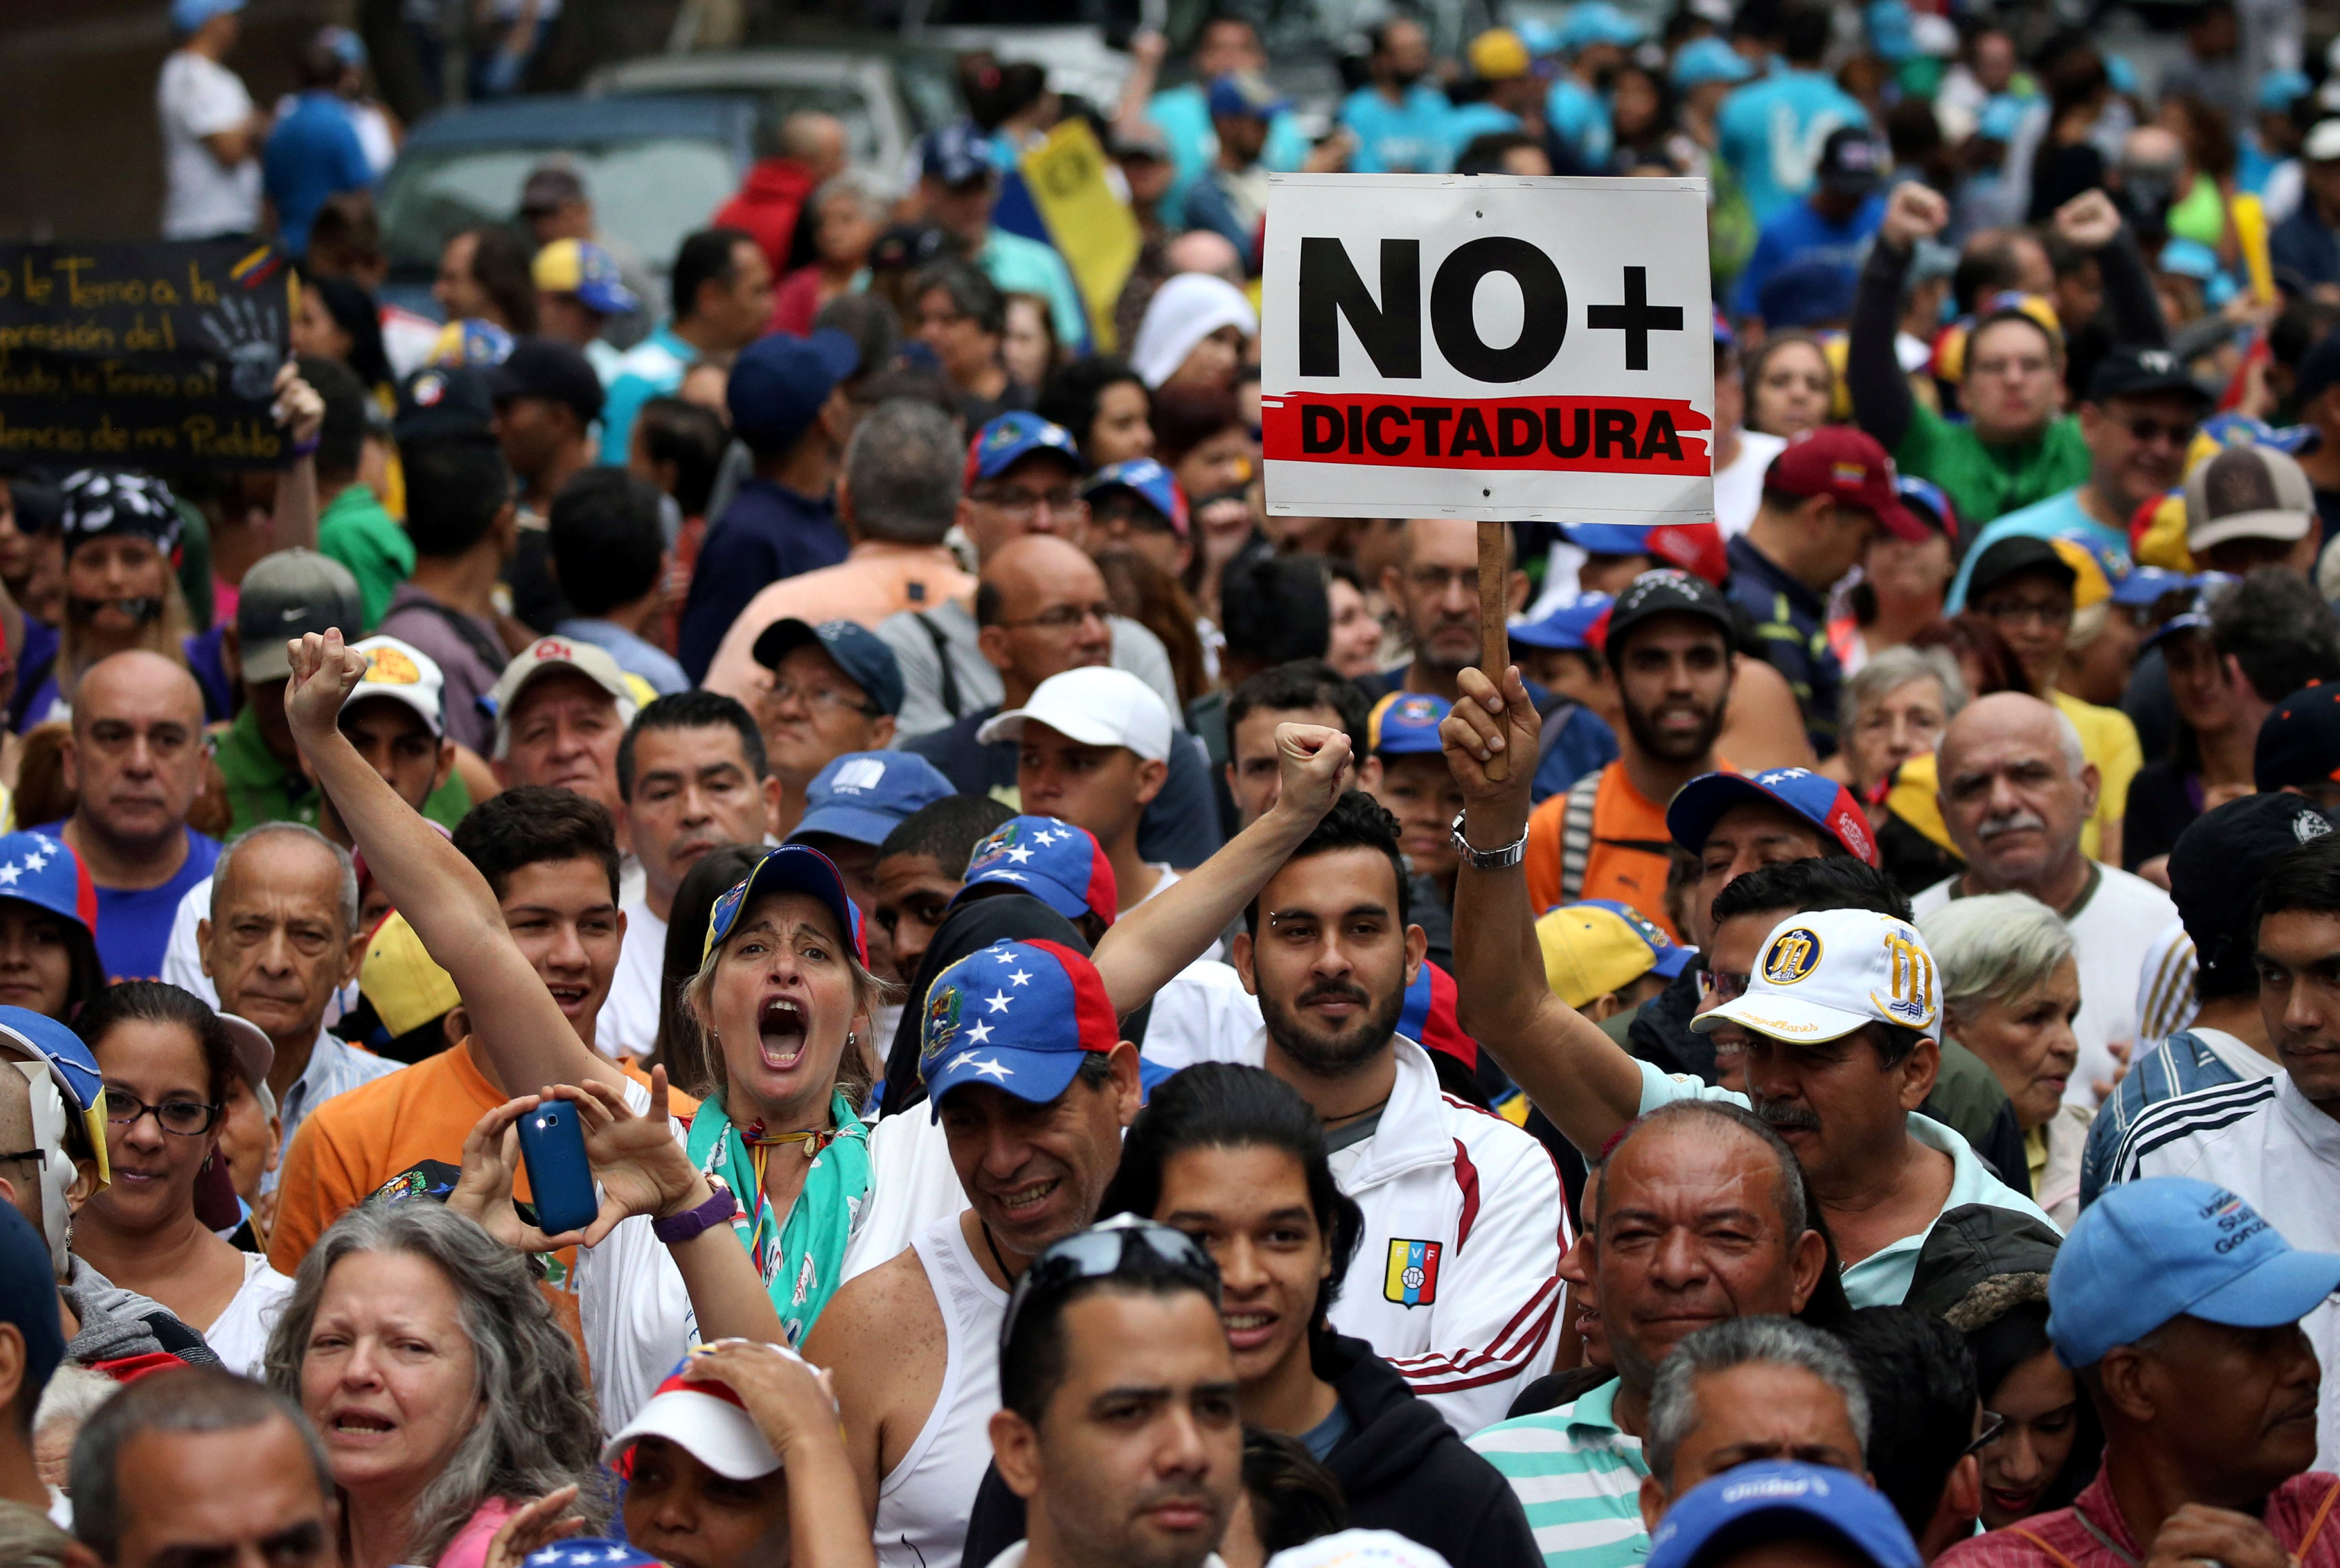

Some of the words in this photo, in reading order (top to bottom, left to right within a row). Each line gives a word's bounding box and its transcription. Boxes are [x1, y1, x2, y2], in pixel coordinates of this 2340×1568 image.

[23, 253, 54, 304] le
[151, 279, 181, 305] a
[189, 260, 219, 305] la
[125, 311, 177, 352] del
[91, 413, 128, 452] de
[1300, 404, 1685, 461] DICTADURA
